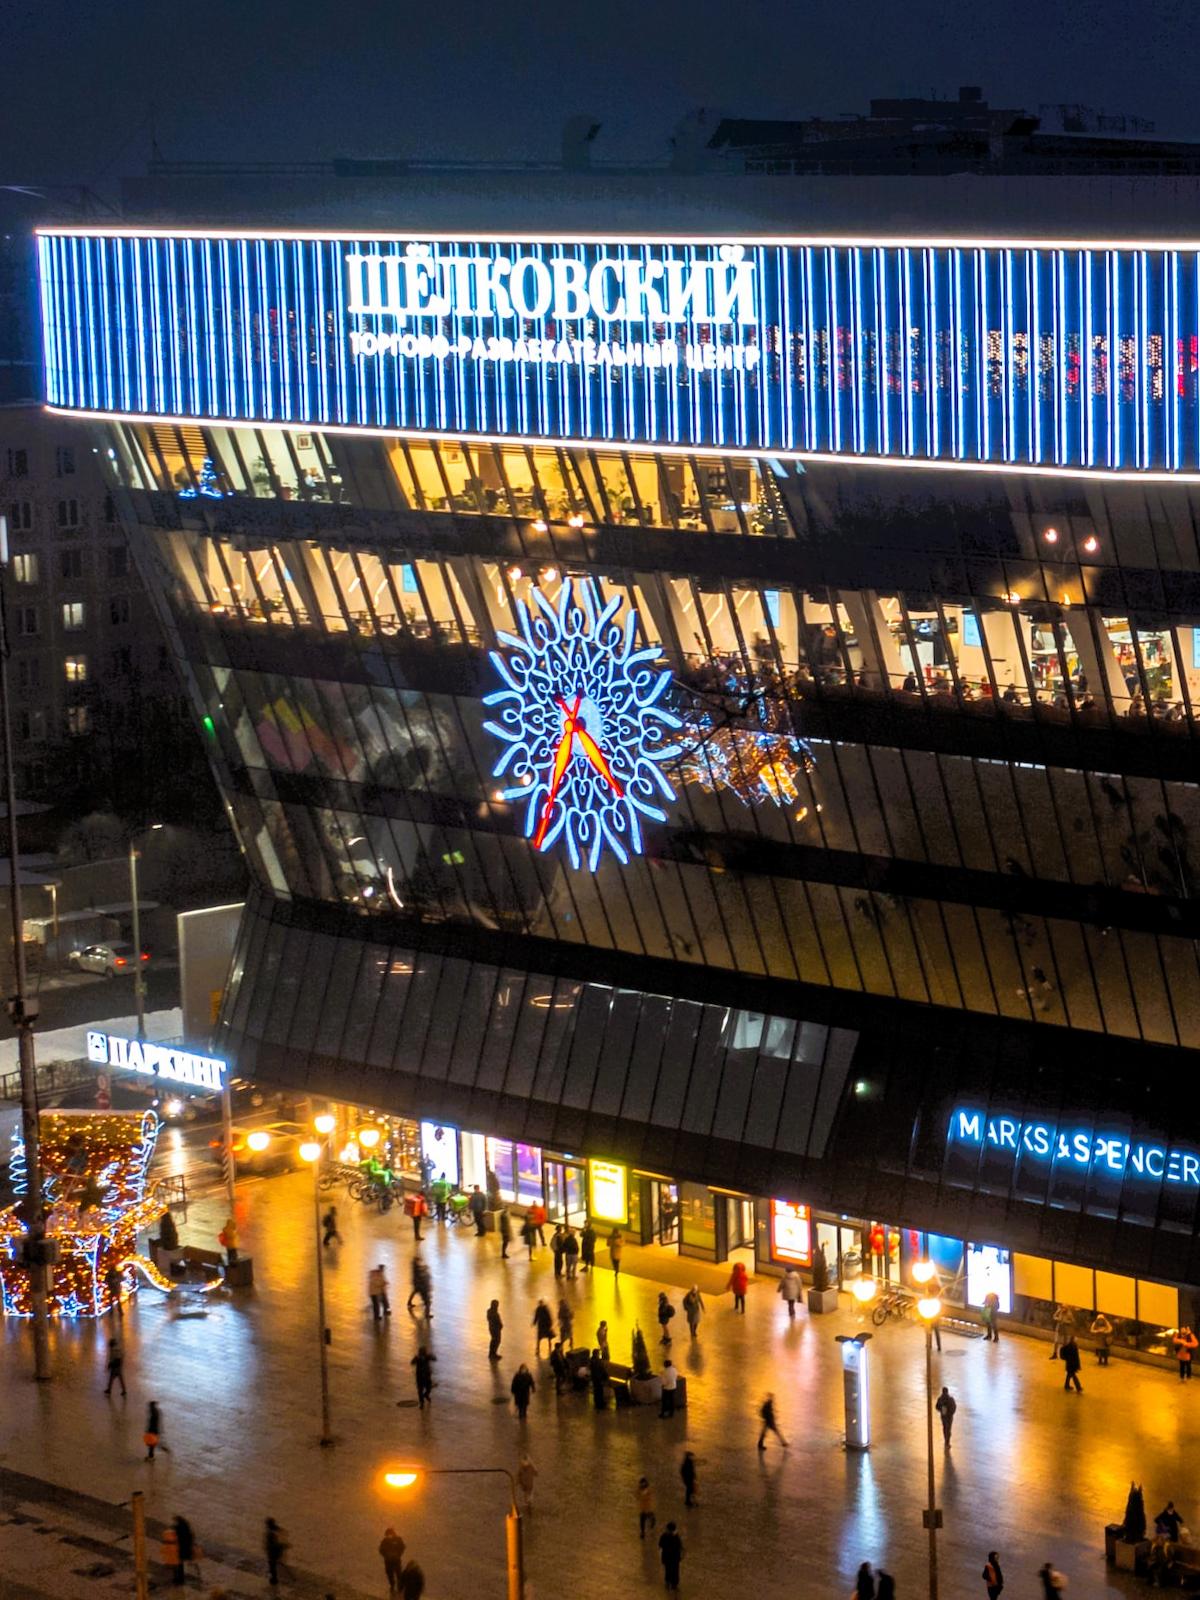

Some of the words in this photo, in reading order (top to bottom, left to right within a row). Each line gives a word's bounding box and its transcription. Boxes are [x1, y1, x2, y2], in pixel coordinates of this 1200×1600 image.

[346, 244, 759, 328] ЩЁЛКОВСКИЙ
[350, 331, 678, 369] ТОРГОВО-РАЗВЛЕКАТЕЛЬНЫЙ
[686, 345, 761, 372] ЦЕНТР
[108, 1035, 226, 1091] ПАРКИНГ
